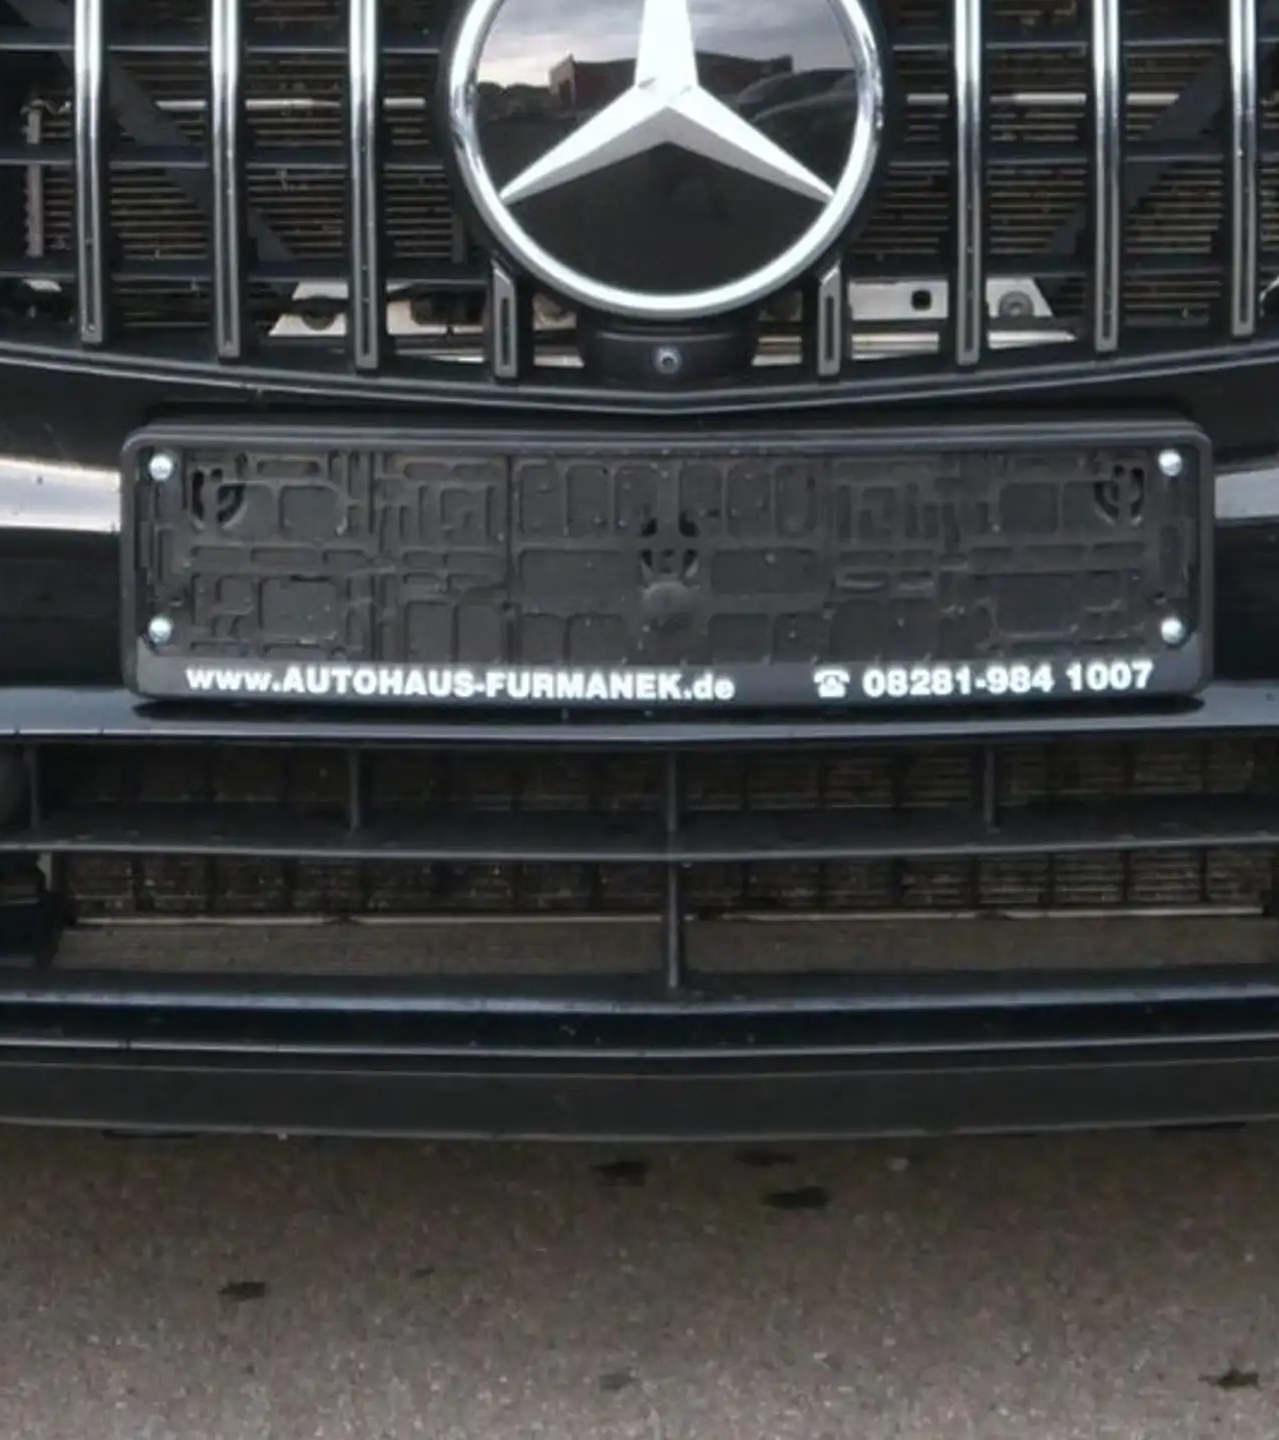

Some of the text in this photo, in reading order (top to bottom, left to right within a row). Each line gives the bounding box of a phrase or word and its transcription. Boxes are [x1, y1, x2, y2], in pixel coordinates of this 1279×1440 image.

[184, 663, 736, 700] www.AUTOHAUS-FURMANEK.de
[861, 659, 1154, 697] 08281-984 1007
